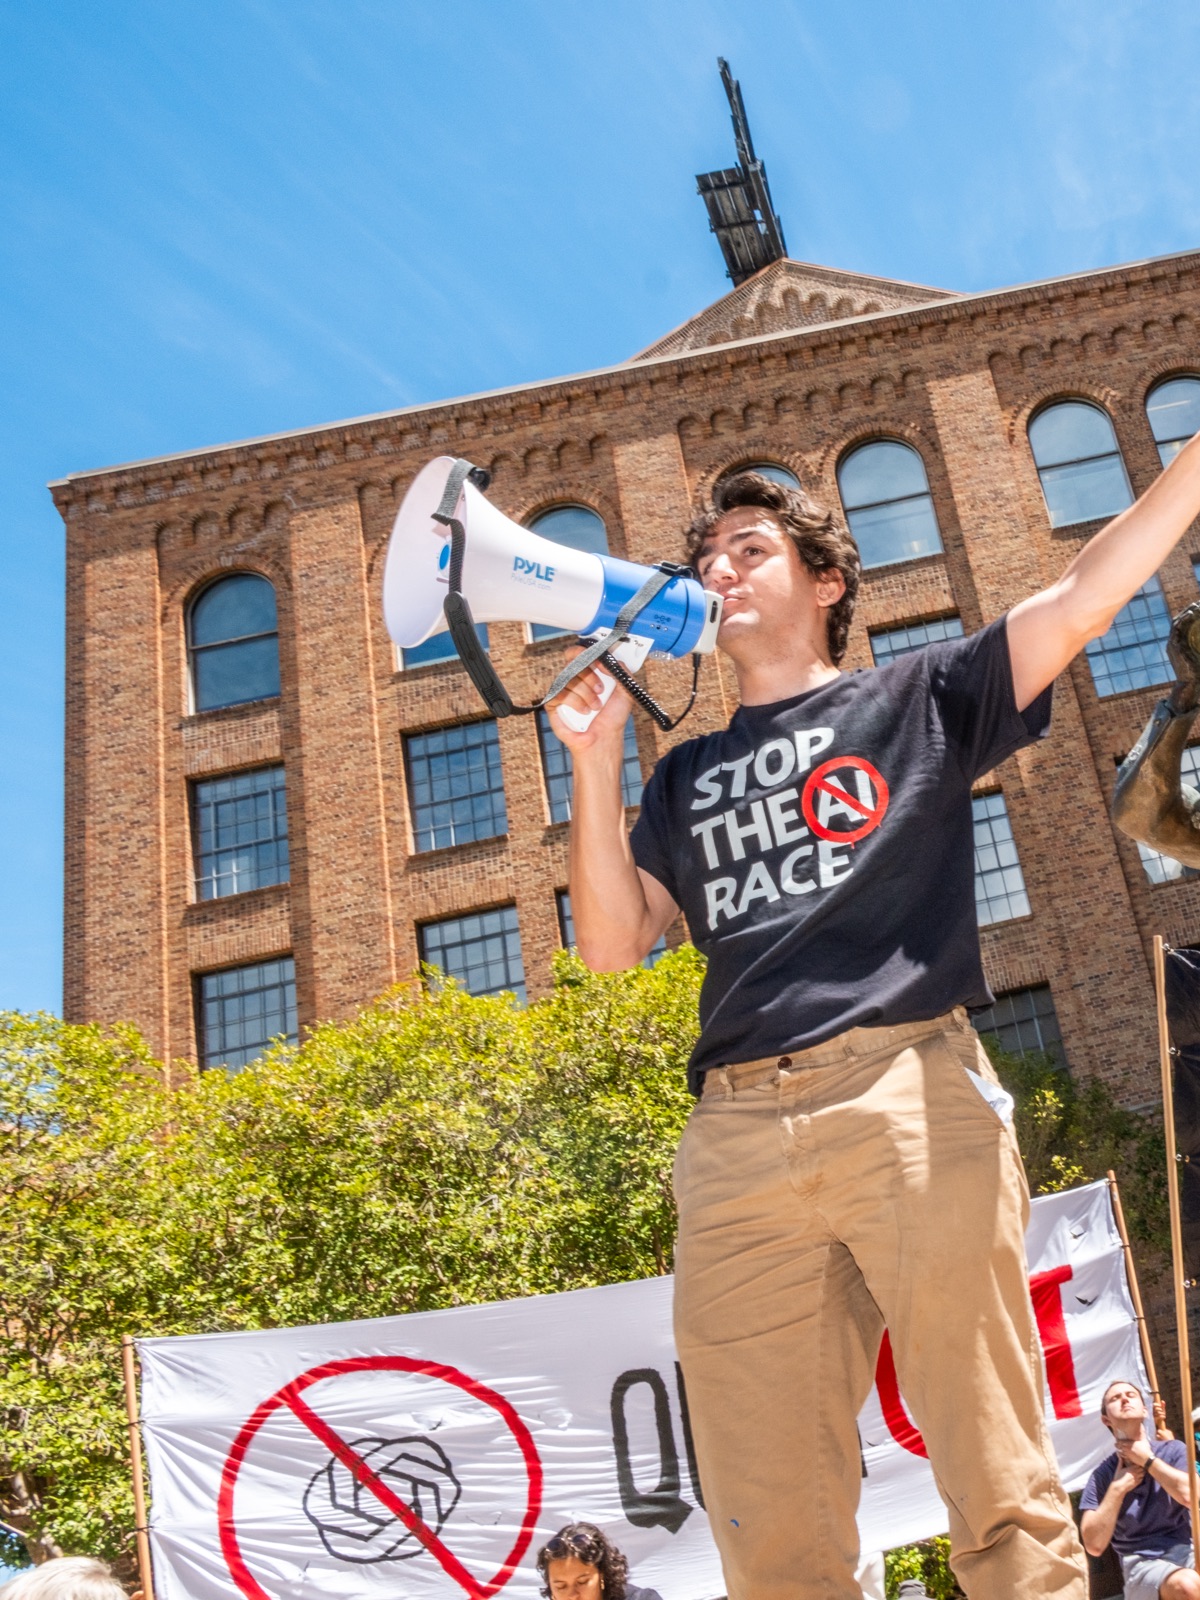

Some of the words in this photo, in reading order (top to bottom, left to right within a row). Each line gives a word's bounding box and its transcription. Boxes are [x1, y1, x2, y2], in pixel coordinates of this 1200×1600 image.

[690, 727, 835, 811] STOP
[690, 787, 810, 871] THE
[817, 769, 876, 829] AI
[703, 840, 855, 932] RACE
